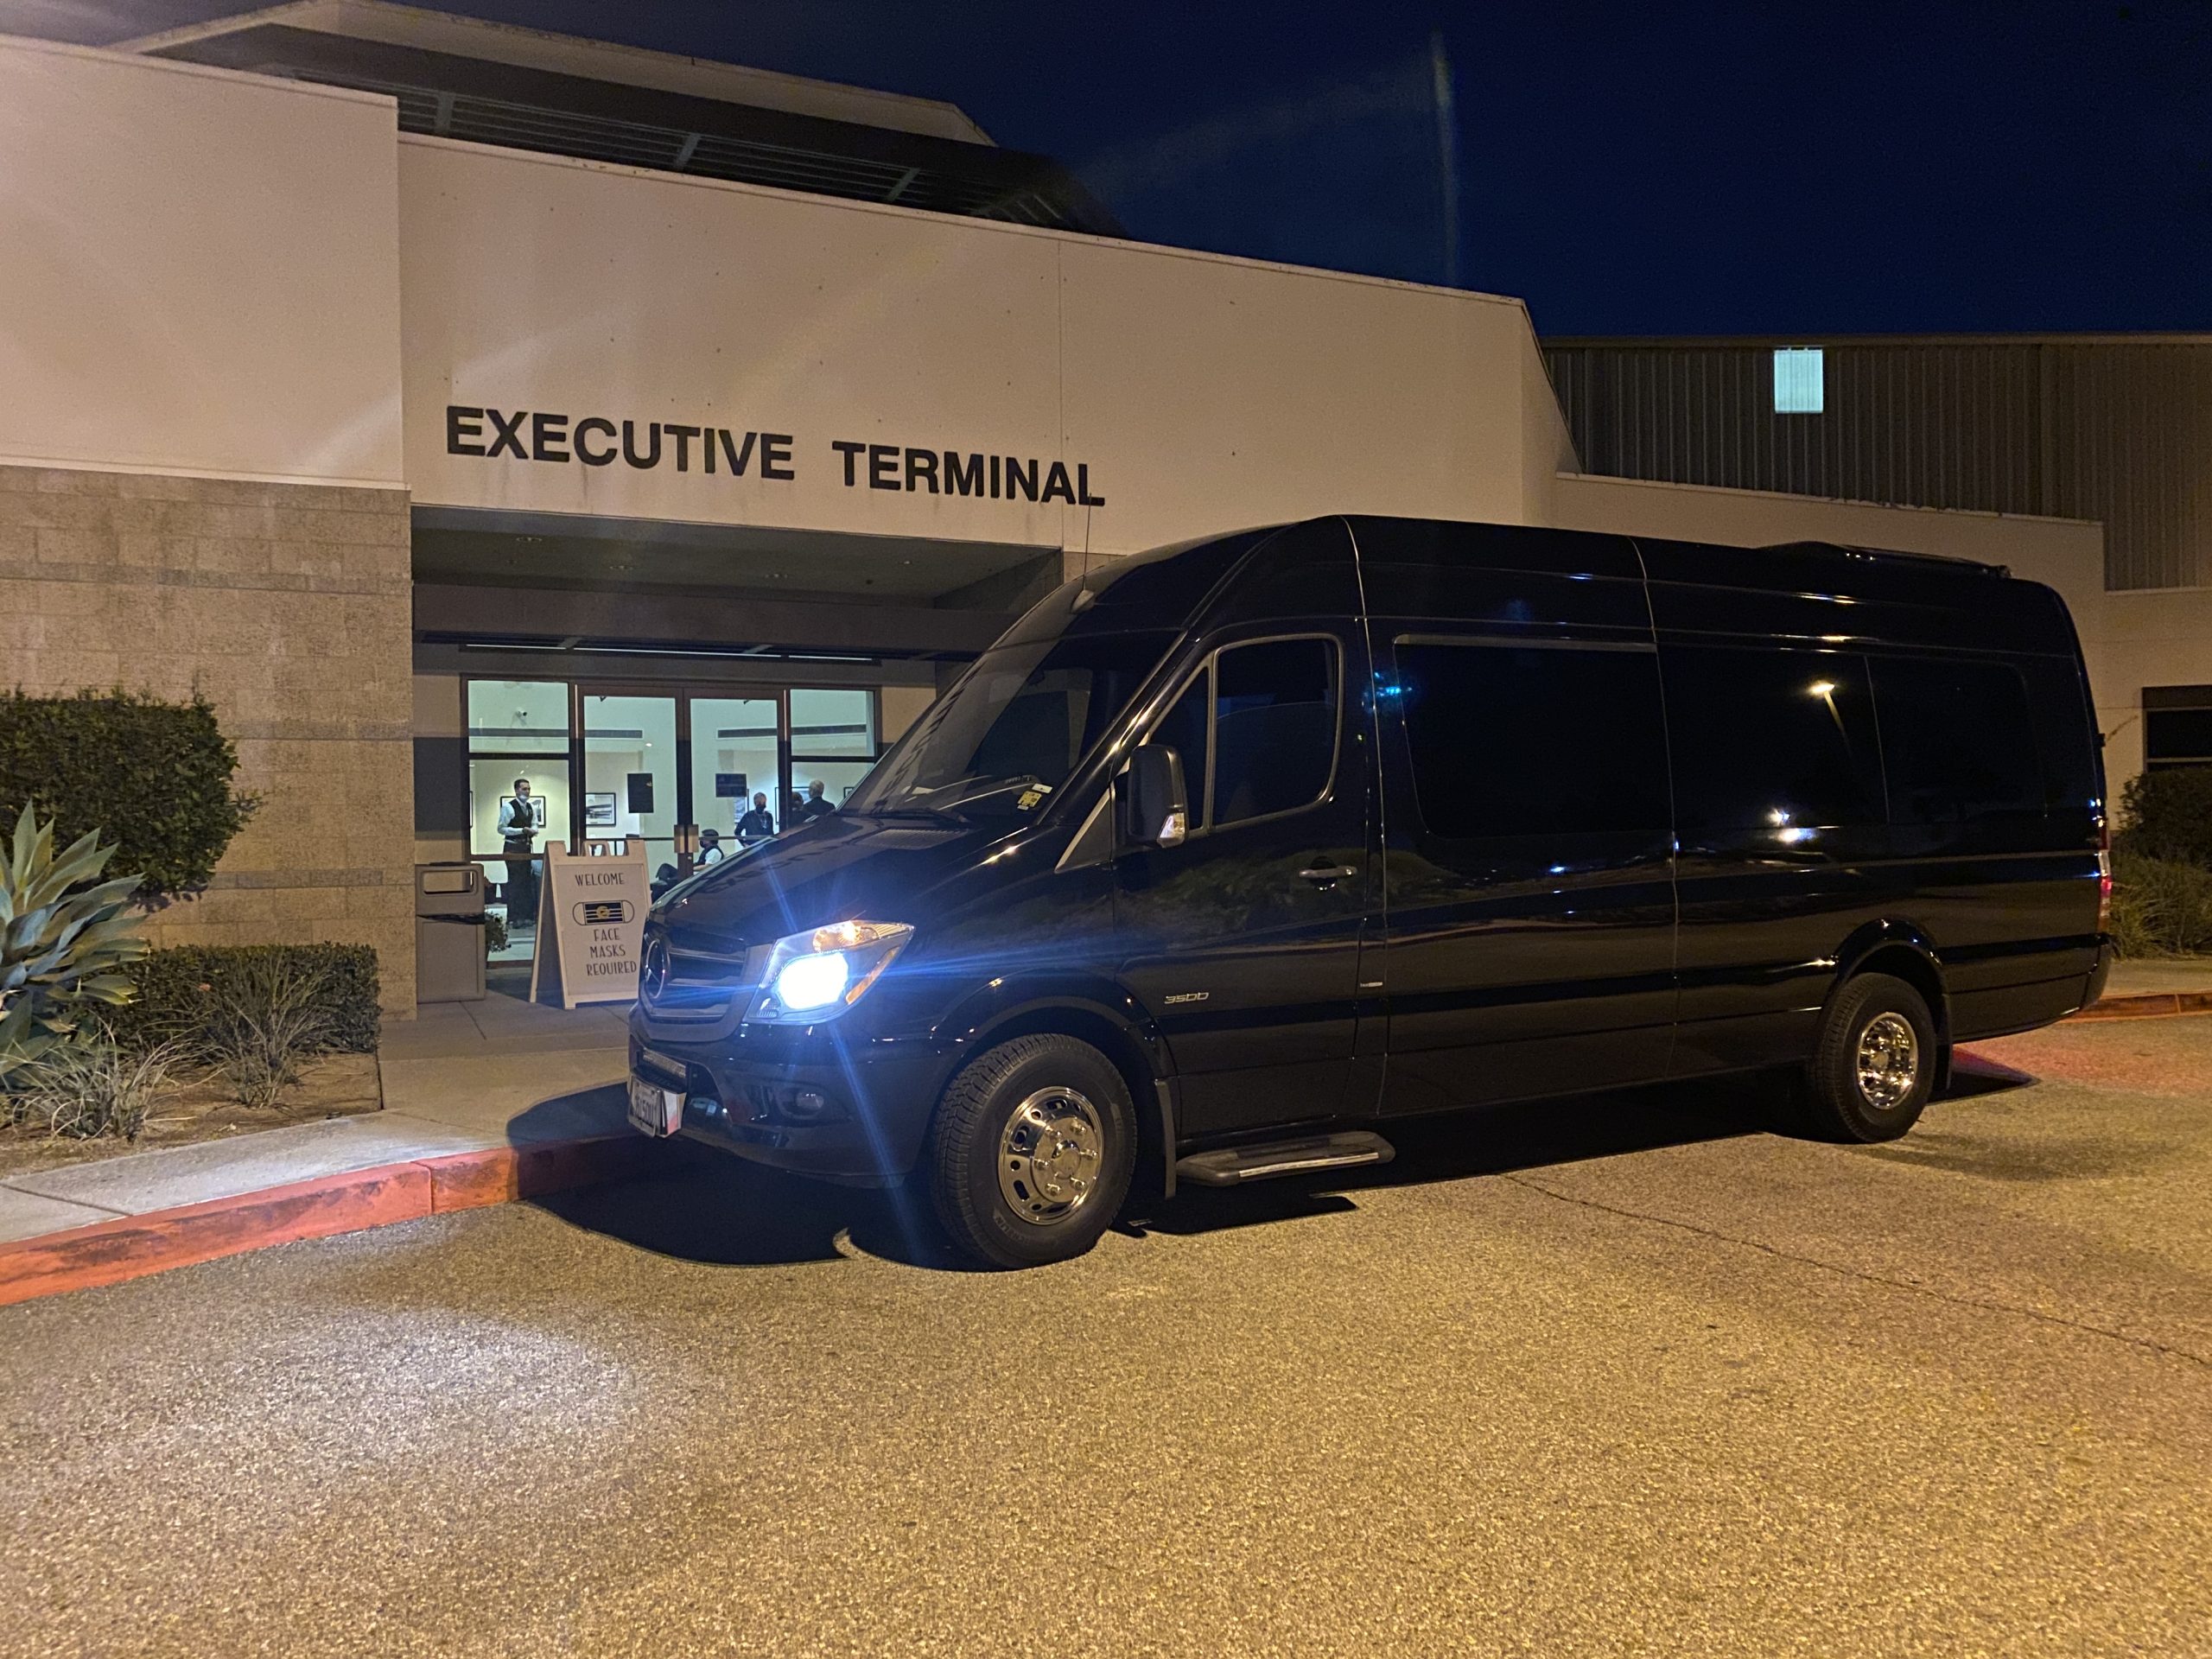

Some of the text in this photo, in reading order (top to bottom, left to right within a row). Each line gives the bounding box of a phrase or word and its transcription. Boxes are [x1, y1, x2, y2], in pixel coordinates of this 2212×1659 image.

[446, 405, 1106, 507] EXECUTIVE TERMINAL
[575, 872, 626, 887] WELCOME
[593, 928, 621, 942] FACE
[589, 944, 626, 959] MASKS
[586, 960, 638, 976] REQUIRED
[1164, 992, 1210, 1004] 3500
